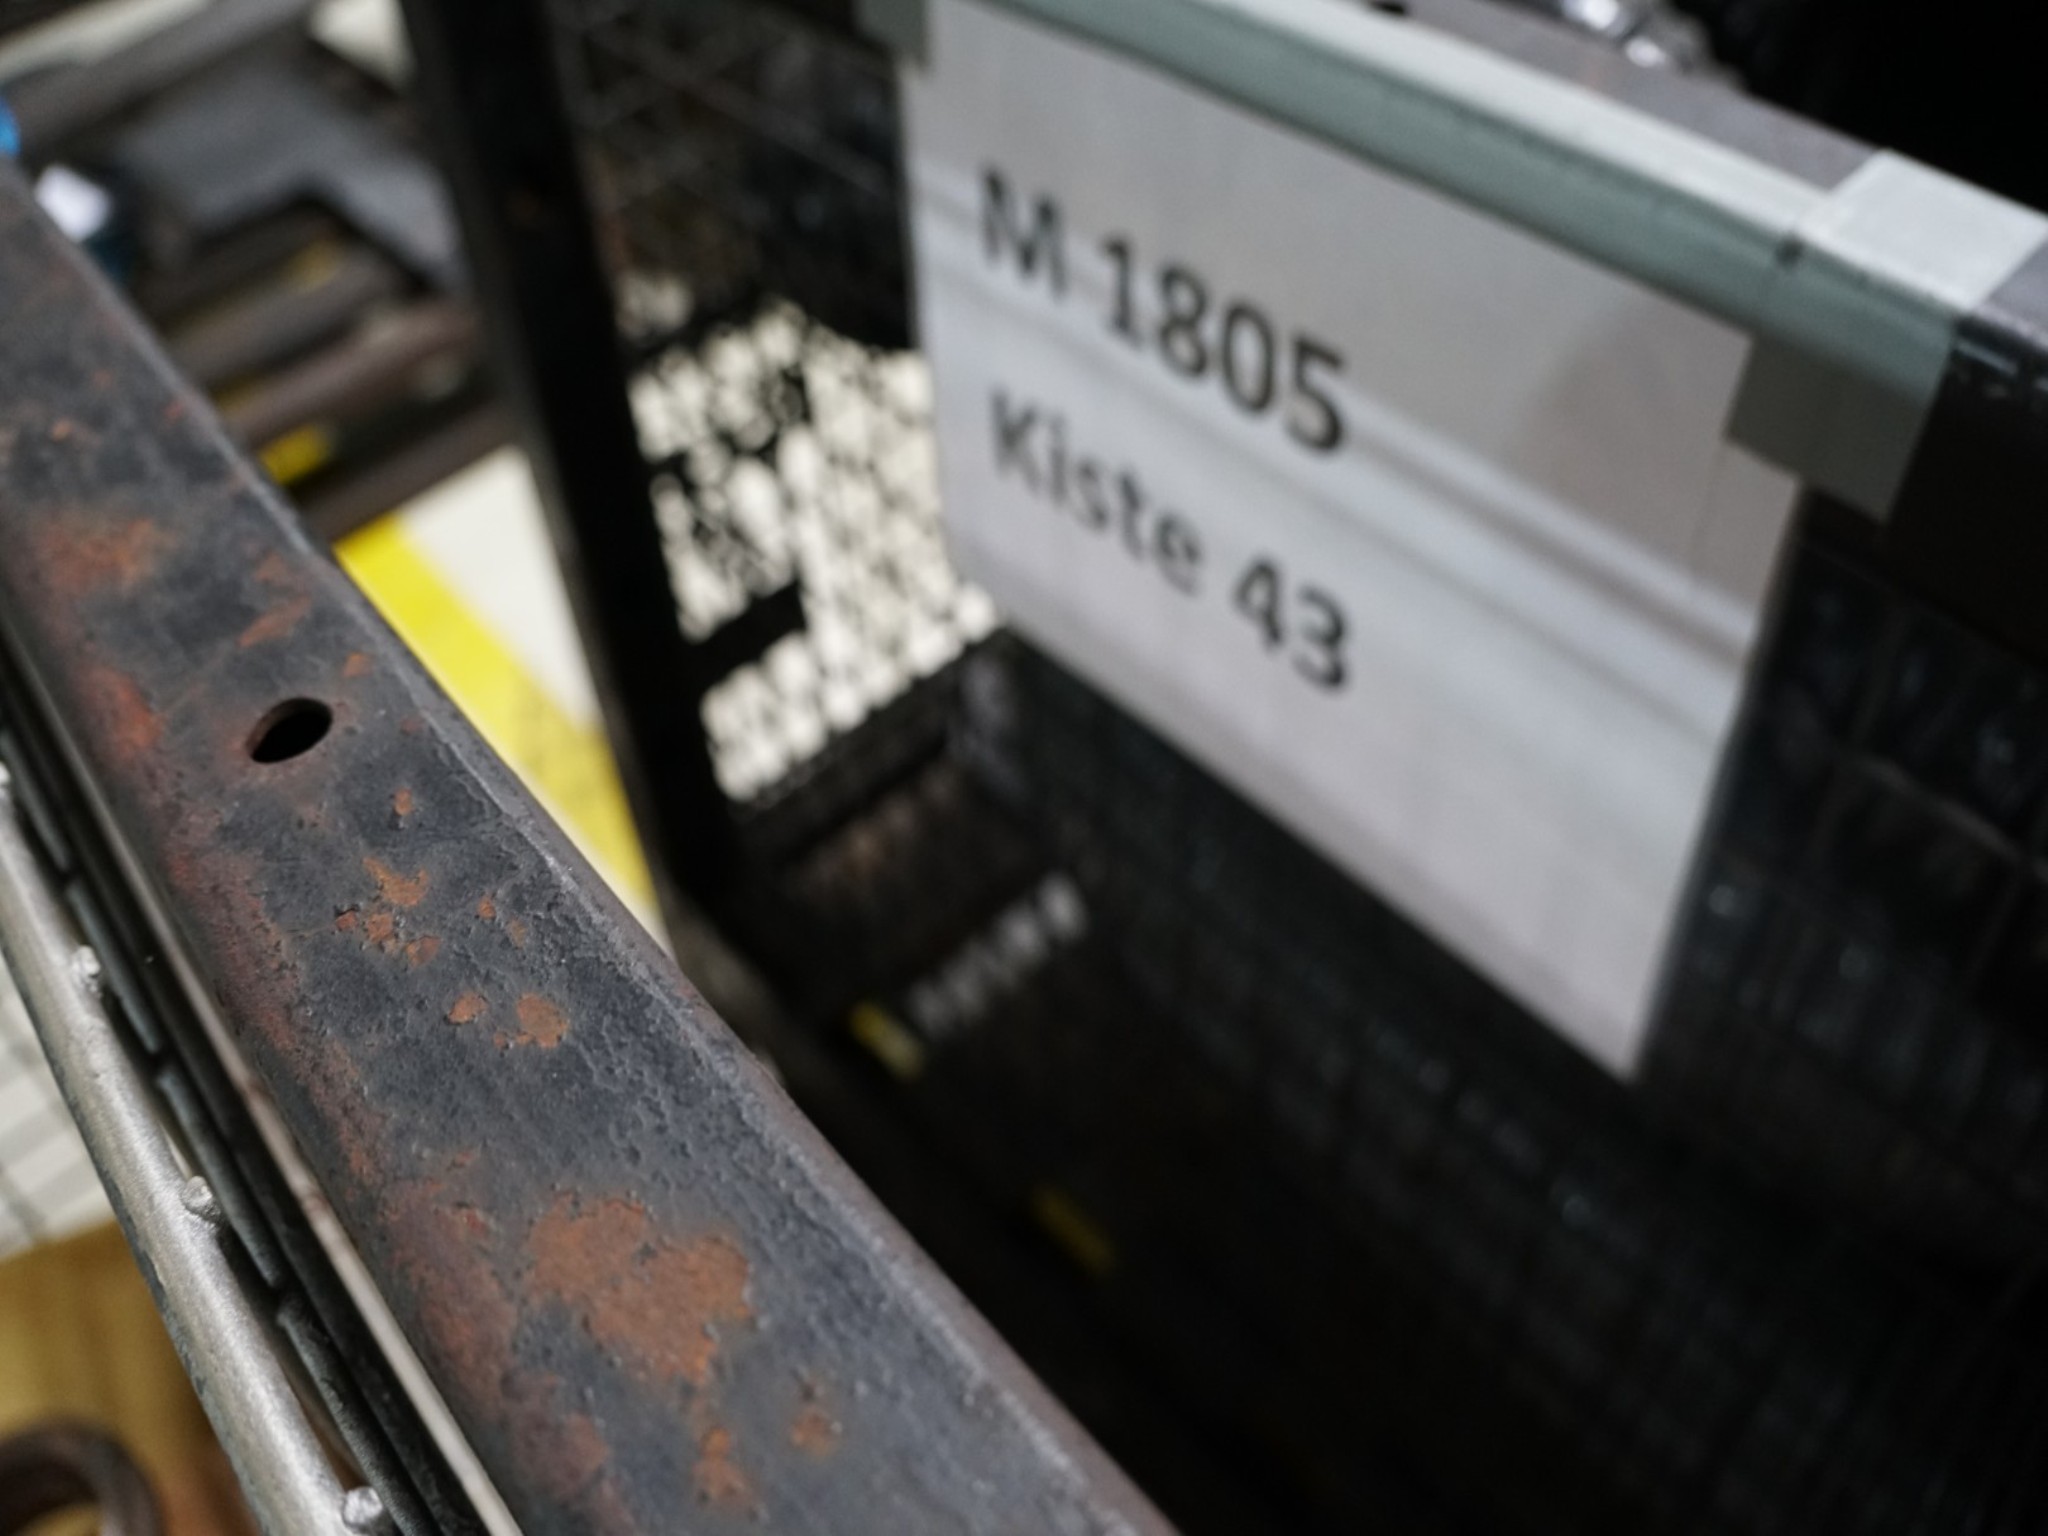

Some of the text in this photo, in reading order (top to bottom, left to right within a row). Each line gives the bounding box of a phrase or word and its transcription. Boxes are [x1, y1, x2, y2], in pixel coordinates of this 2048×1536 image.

[982, 166, 1350, 458] M 1805
[991, 390, 1352, 695] Kiste 43
